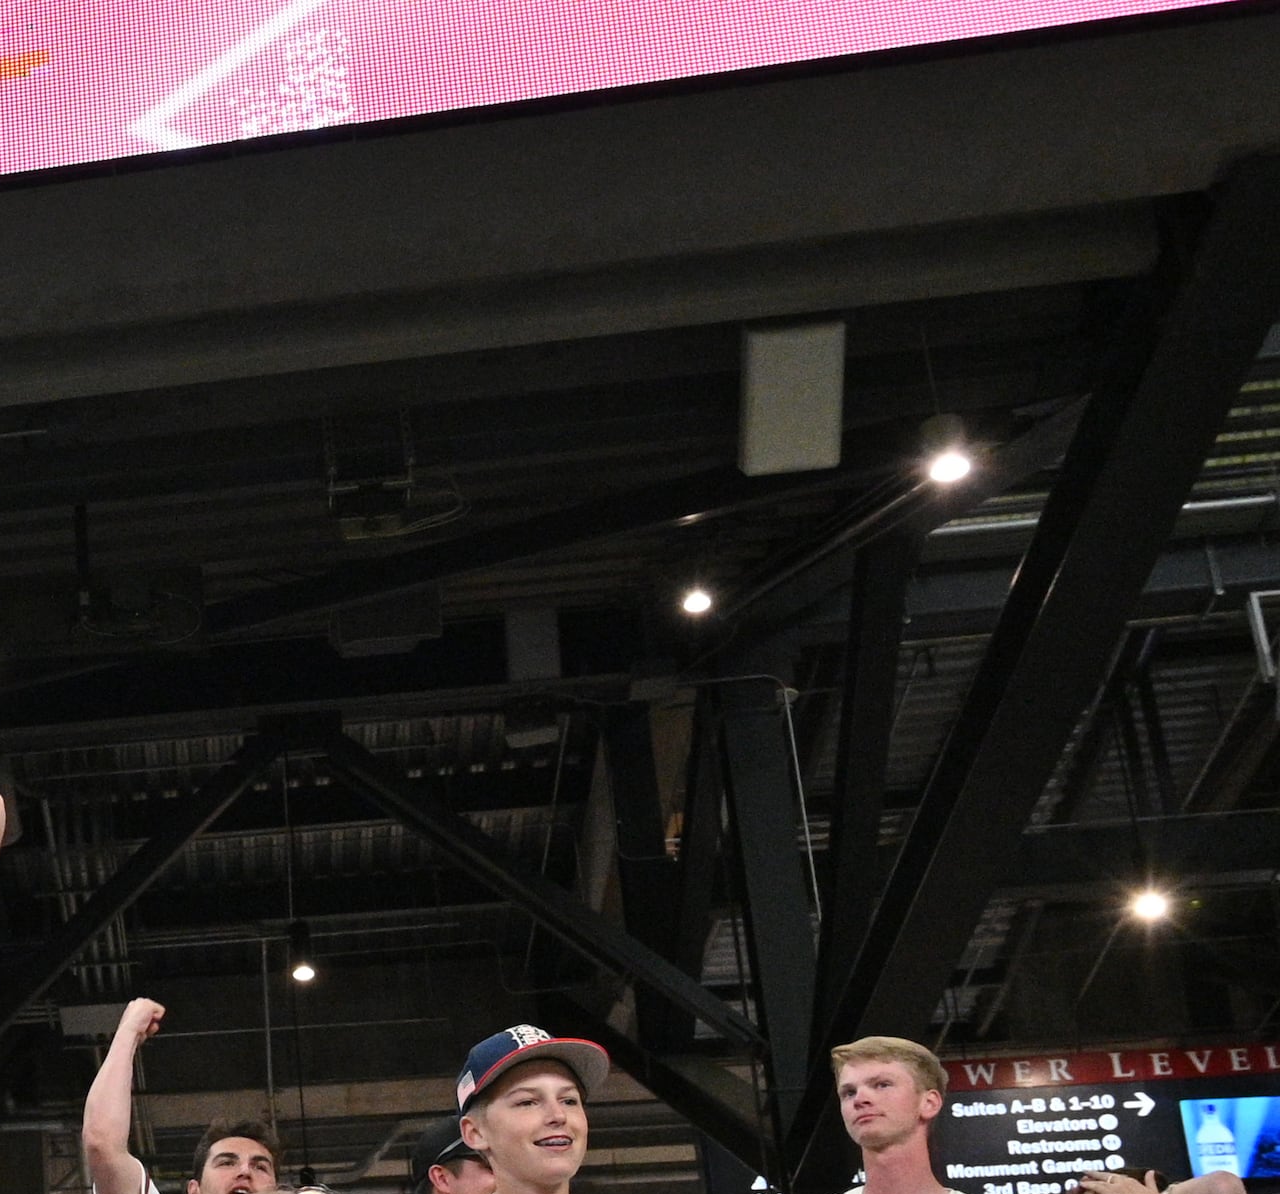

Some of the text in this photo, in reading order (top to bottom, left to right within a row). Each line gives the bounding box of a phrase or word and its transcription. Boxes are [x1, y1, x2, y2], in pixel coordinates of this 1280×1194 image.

[962, 1058, 1074, 1086] WER
[951, 1101, 1007, 1118] Suites
[1049, 1097, 1066, 1112] &
[1016, 1116, 1098, 1134] Elevators
[1007, 1137, 1101, 1155] Restrooms
[946, 1157, 1105, 1179] Monument Garden
